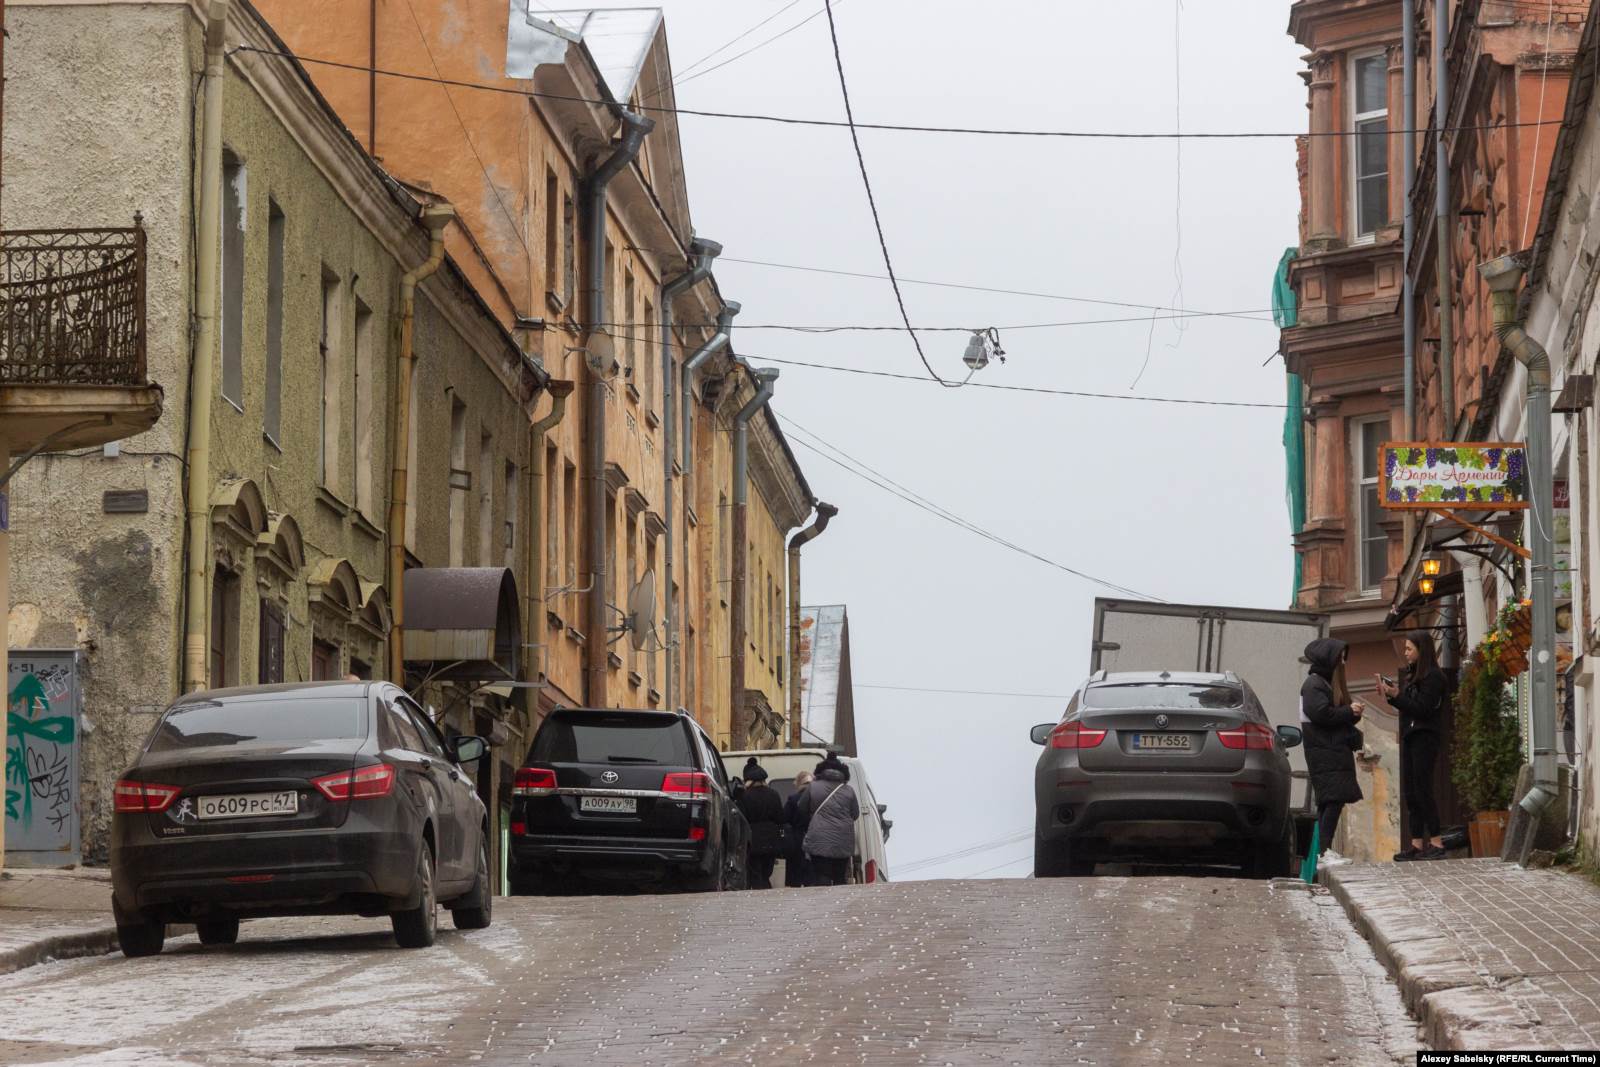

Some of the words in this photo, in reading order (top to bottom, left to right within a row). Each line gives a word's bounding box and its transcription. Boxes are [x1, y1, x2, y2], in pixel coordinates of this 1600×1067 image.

[1394, 466, 1437, 485] Дары
[1440, 463, 1506, 486] Армении
[1142, 735, 1188, 747] TTY-552
